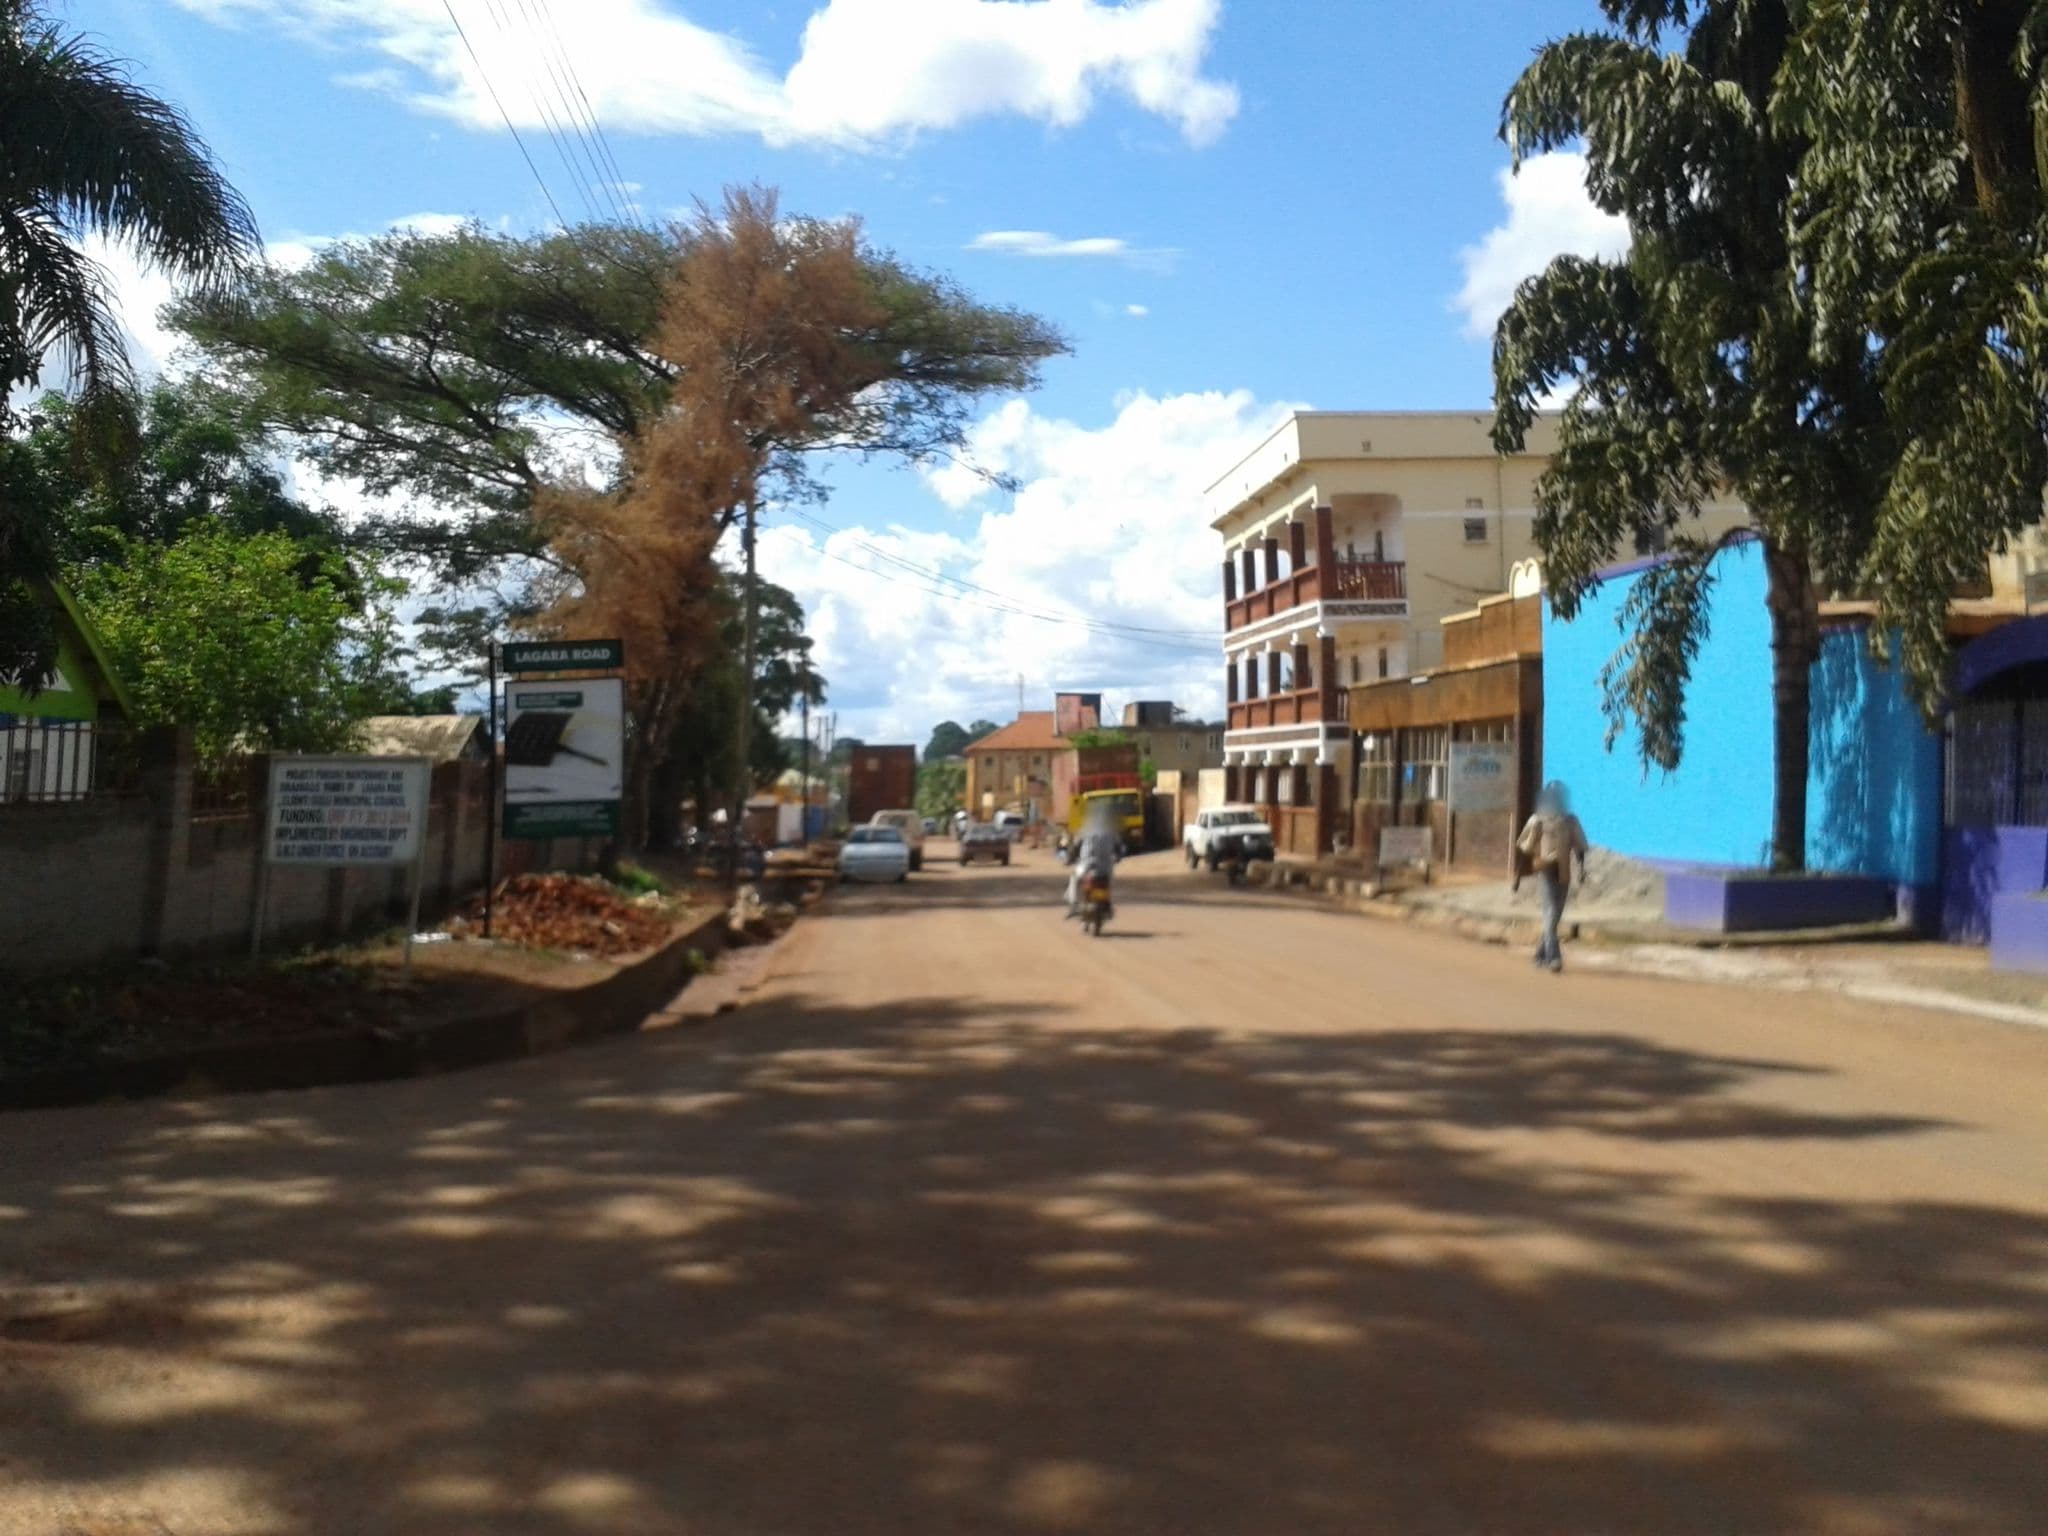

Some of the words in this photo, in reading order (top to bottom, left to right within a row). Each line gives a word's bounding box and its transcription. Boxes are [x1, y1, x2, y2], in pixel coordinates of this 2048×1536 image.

[515, 649, 568, 663] LAGARA
[573, 647, 610, 660] ROAD
[374, 795, 405, 806] COUNCIL
